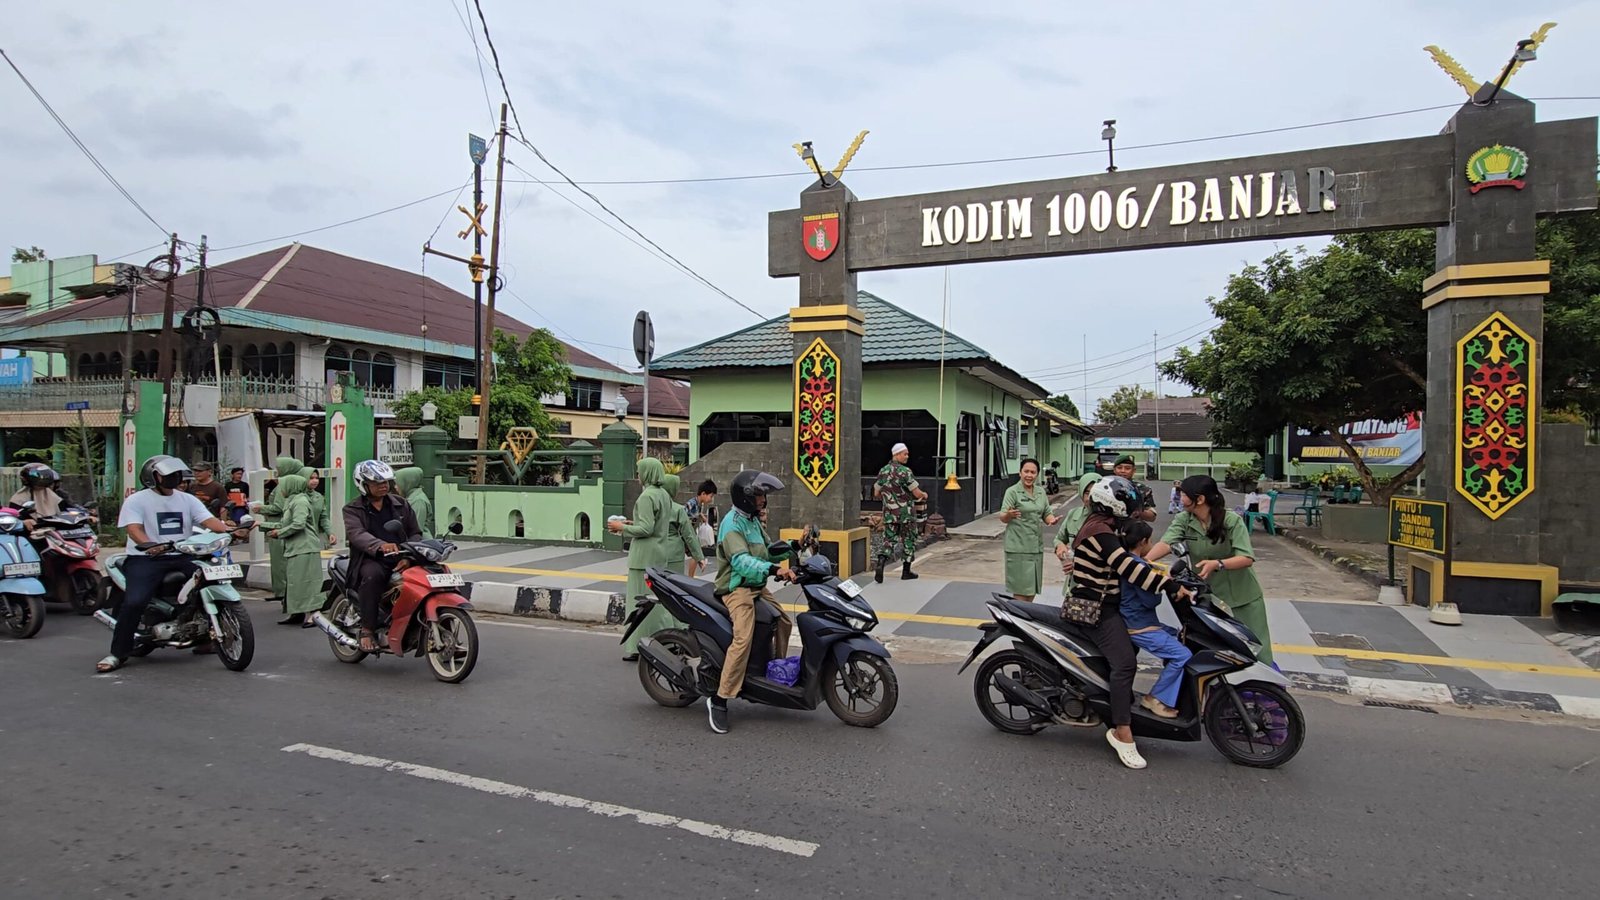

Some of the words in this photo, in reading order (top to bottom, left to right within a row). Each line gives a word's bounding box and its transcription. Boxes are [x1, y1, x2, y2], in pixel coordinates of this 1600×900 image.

[921, 197, 1033, 247] KODIM
[1046, 166, 1337, 237] 1006/BANJAR
[125, 432, 135, 445] 17
[333, 424, 346, 441] 17
[387, 440, 405, 454] TANJUNG
[1301, 446, 1340, 458] MAKODIM
[1367, 447, 1401, 458] BANJAR
[127, 459, 133, 473] 8
[391, 455, 414, 463] MARTAPU
[1395, 500, 1417, 513] PINTU
[1417, 503, 1422, 514] 1
